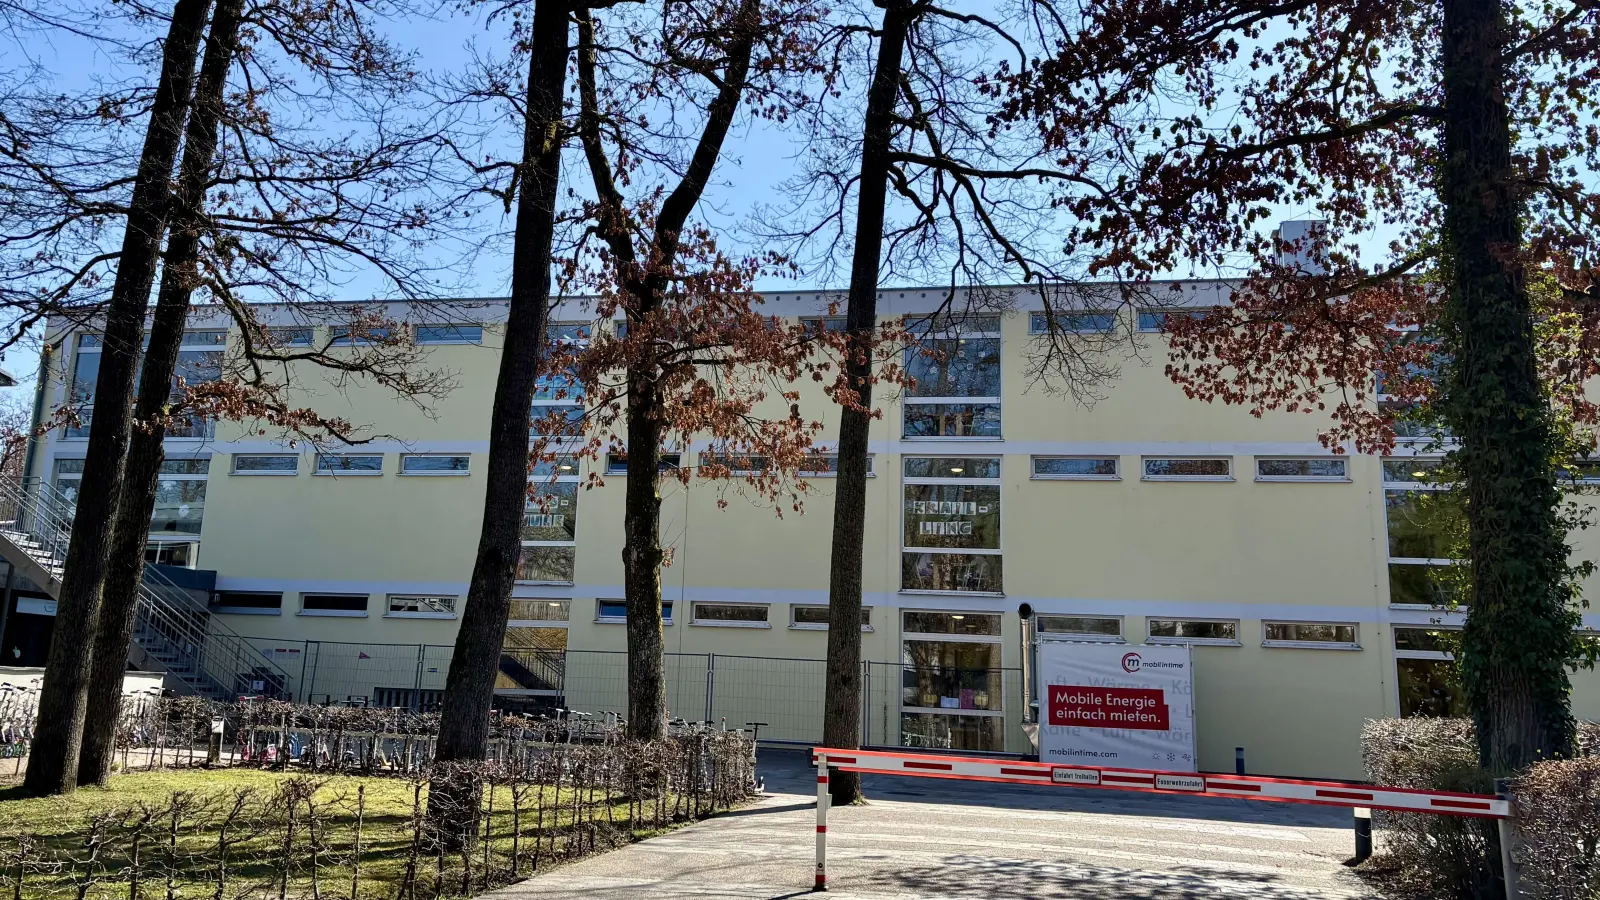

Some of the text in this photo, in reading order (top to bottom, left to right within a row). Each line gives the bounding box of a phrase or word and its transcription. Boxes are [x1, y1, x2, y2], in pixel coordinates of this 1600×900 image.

[920, 521, 971, 535] LING
[1142, 661, 1184, 669] mobilintime
[1055, 692, 1156, 710] Mobile Energie
[1056, 707, 1161, 723] einfach mieten.
[1049, 748, 1118, 758] mobilintime.com
[1054, 771, 1098, 781] Einfahrt freihalten
[1157, 778, 1203, 788] Feuerwehrzufahrt
